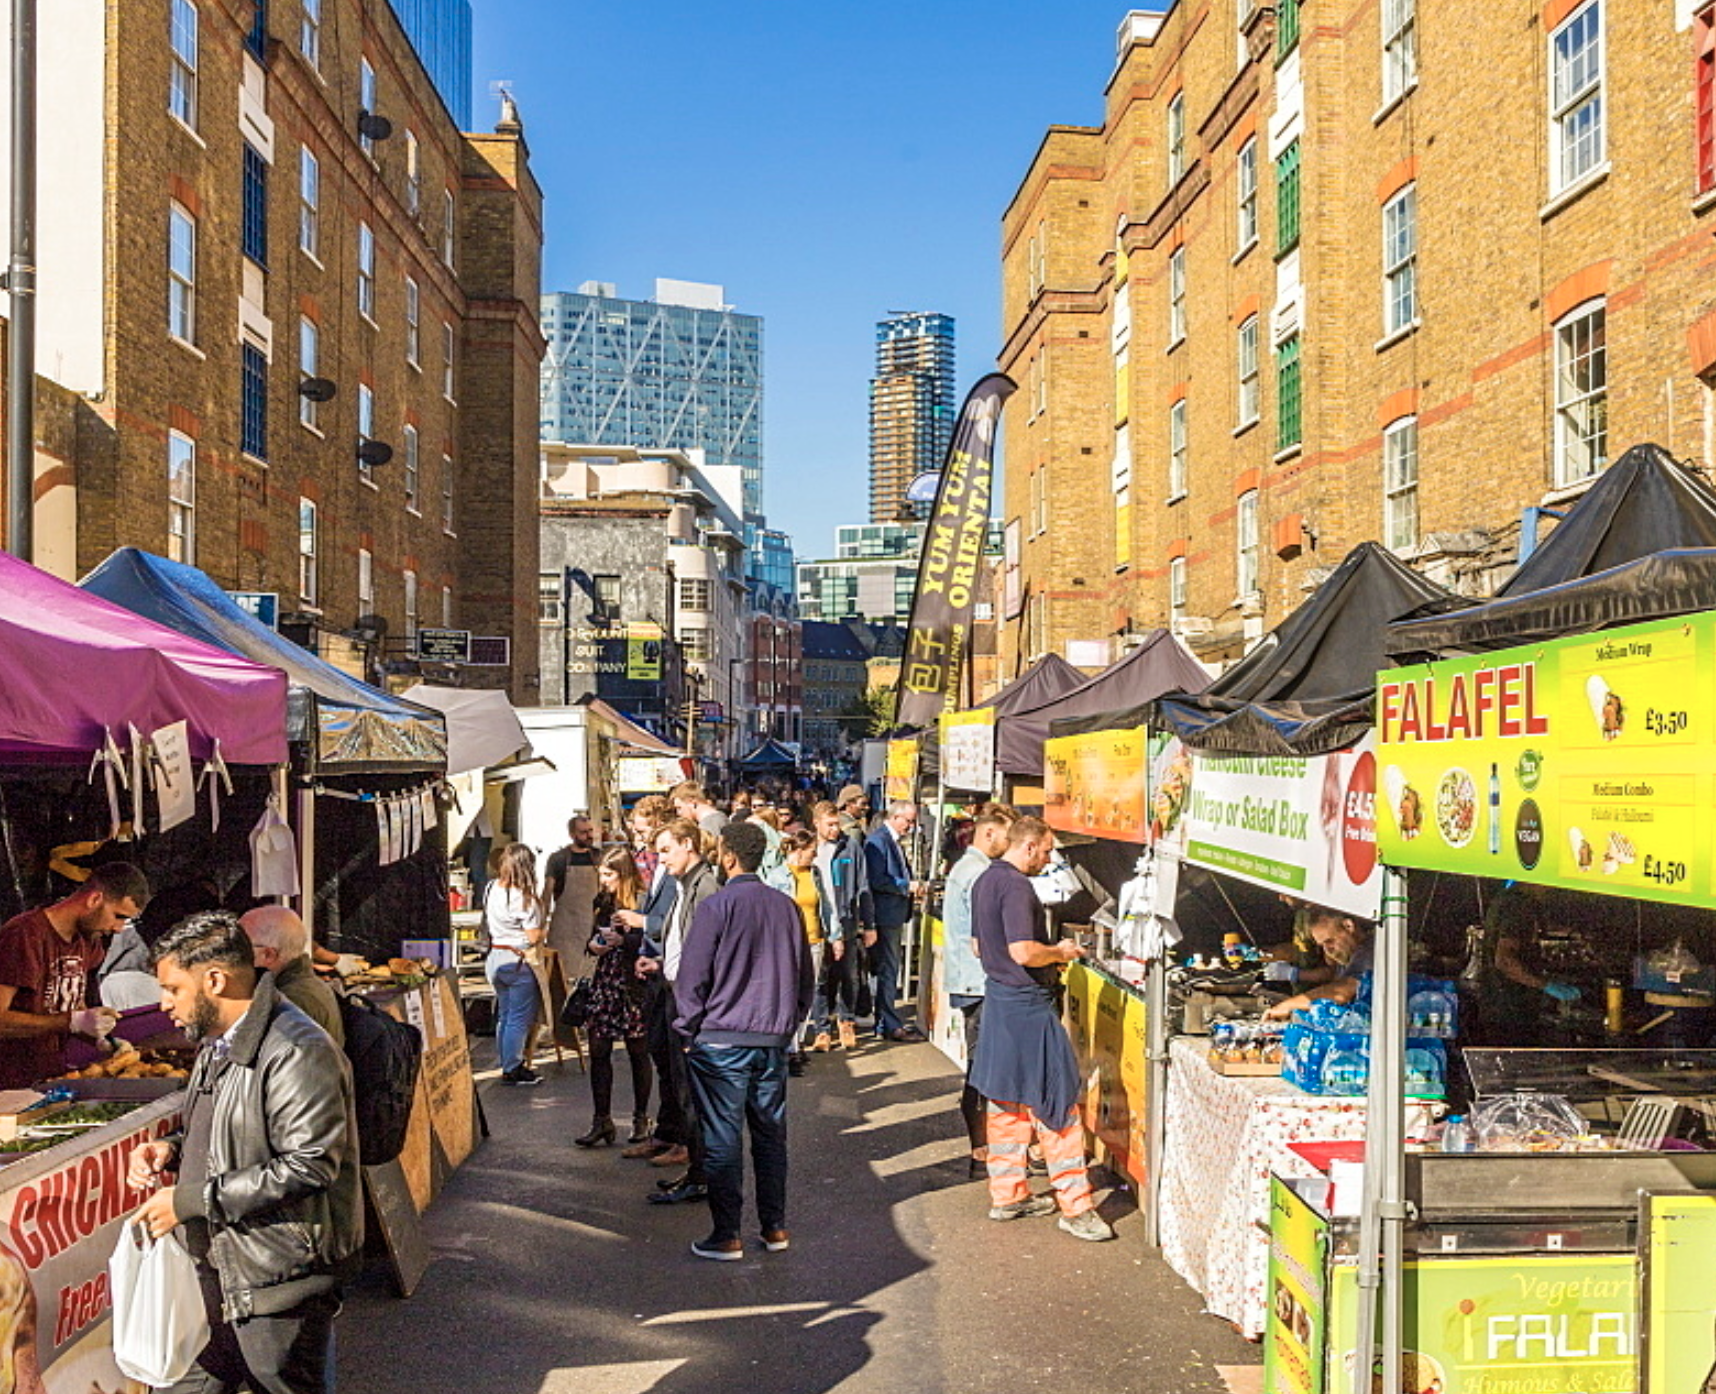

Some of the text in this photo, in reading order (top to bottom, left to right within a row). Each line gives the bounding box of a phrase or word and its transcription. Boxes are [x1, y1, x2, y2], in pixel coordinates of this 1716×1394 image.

[923, 449, 973, 596] YUM YUM
[1381, 662, 1549, 744] FALAFEL
[1645, 708, 1687, 736] £3.50
[1624, 782, 1654, 796] Combo
[1193, 790, 1309, 841] Wrap or Salad Box
[1643, 854, 1685, 885] £4.50
[1567, 1373, 1584, 1392] &
